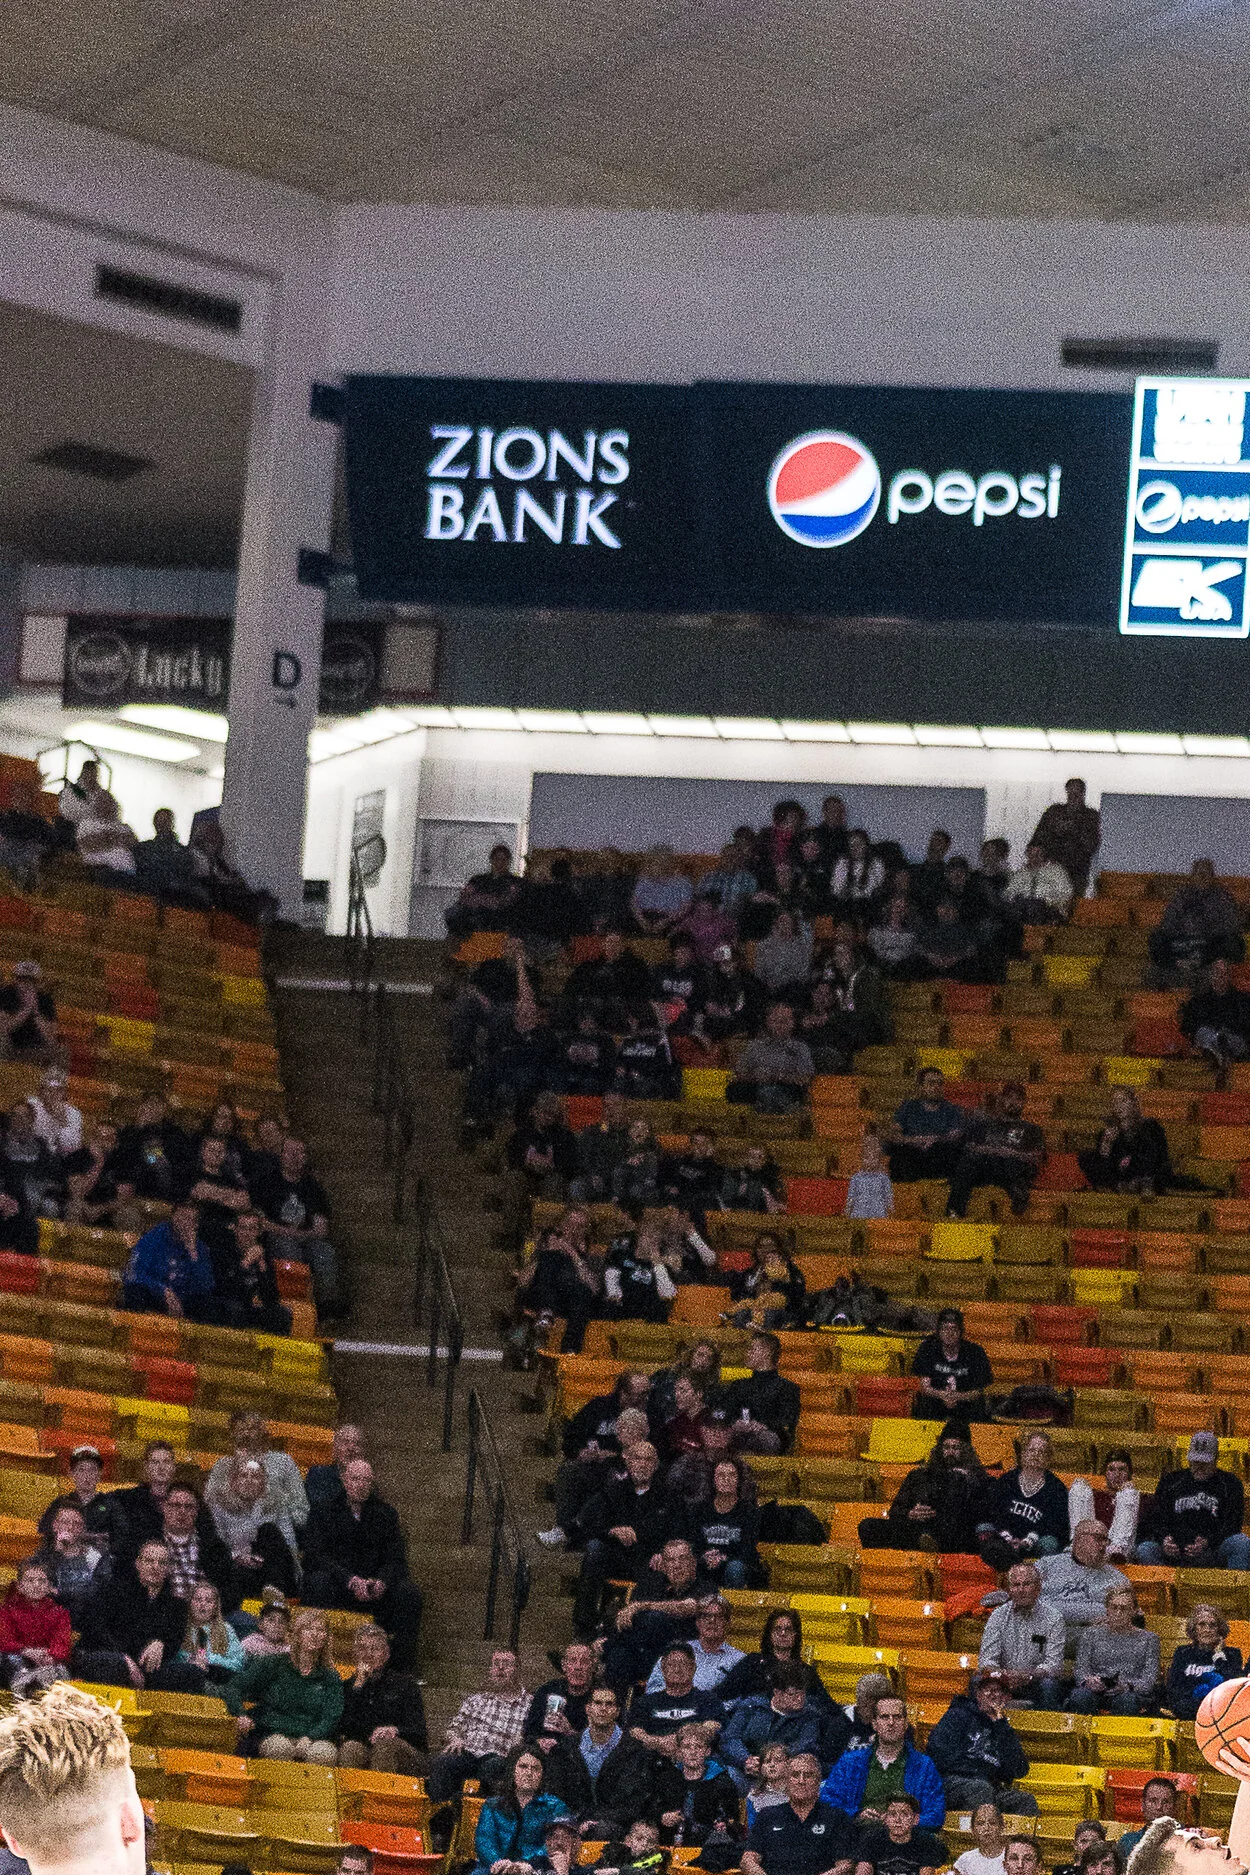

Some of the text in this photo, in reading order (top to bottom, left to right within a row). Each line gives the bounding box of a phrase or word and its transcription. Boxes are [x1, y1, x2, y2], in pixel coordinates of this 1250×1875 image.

[427, 424, 630, 484] ZIONS
[424, 483, 621, 549] BANK
[888, 463, 1061, 526] pepsi
